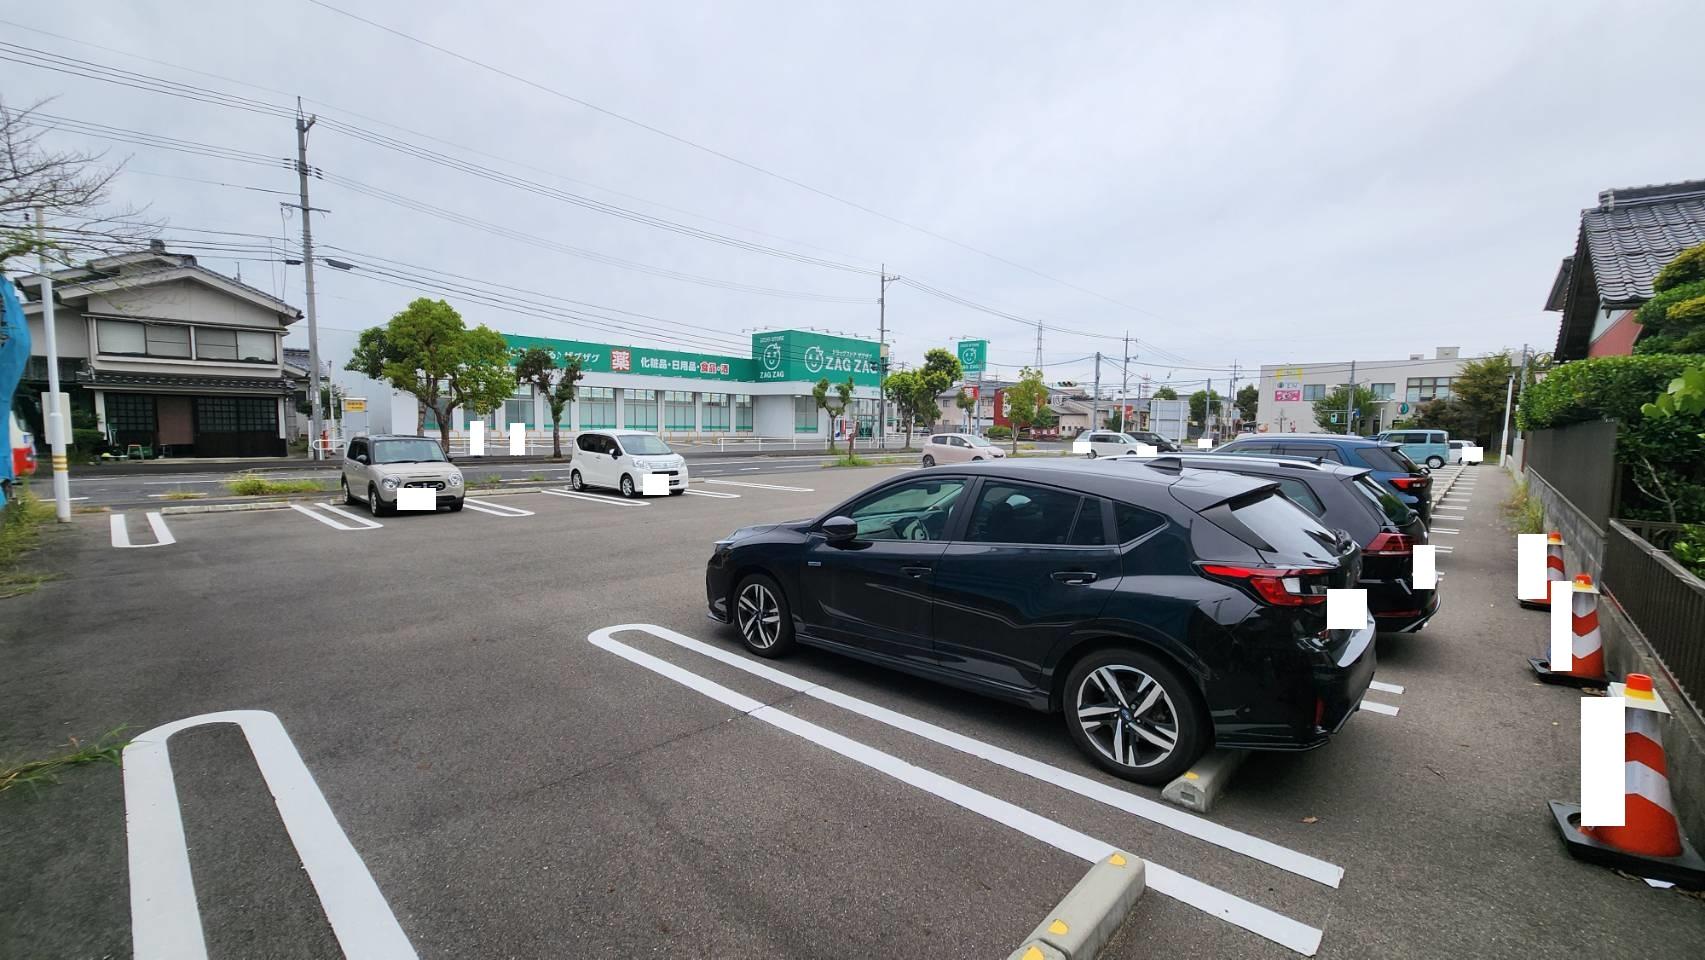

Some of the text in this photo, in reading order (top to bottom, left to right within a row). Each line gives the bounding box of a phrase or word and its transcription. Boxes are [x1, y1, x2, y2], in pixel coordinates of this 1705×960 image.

[611, 350, 630, 371] 薬
[825, 356, 851, 372] ZAG
[760, 371, 771, 379] ZAG
